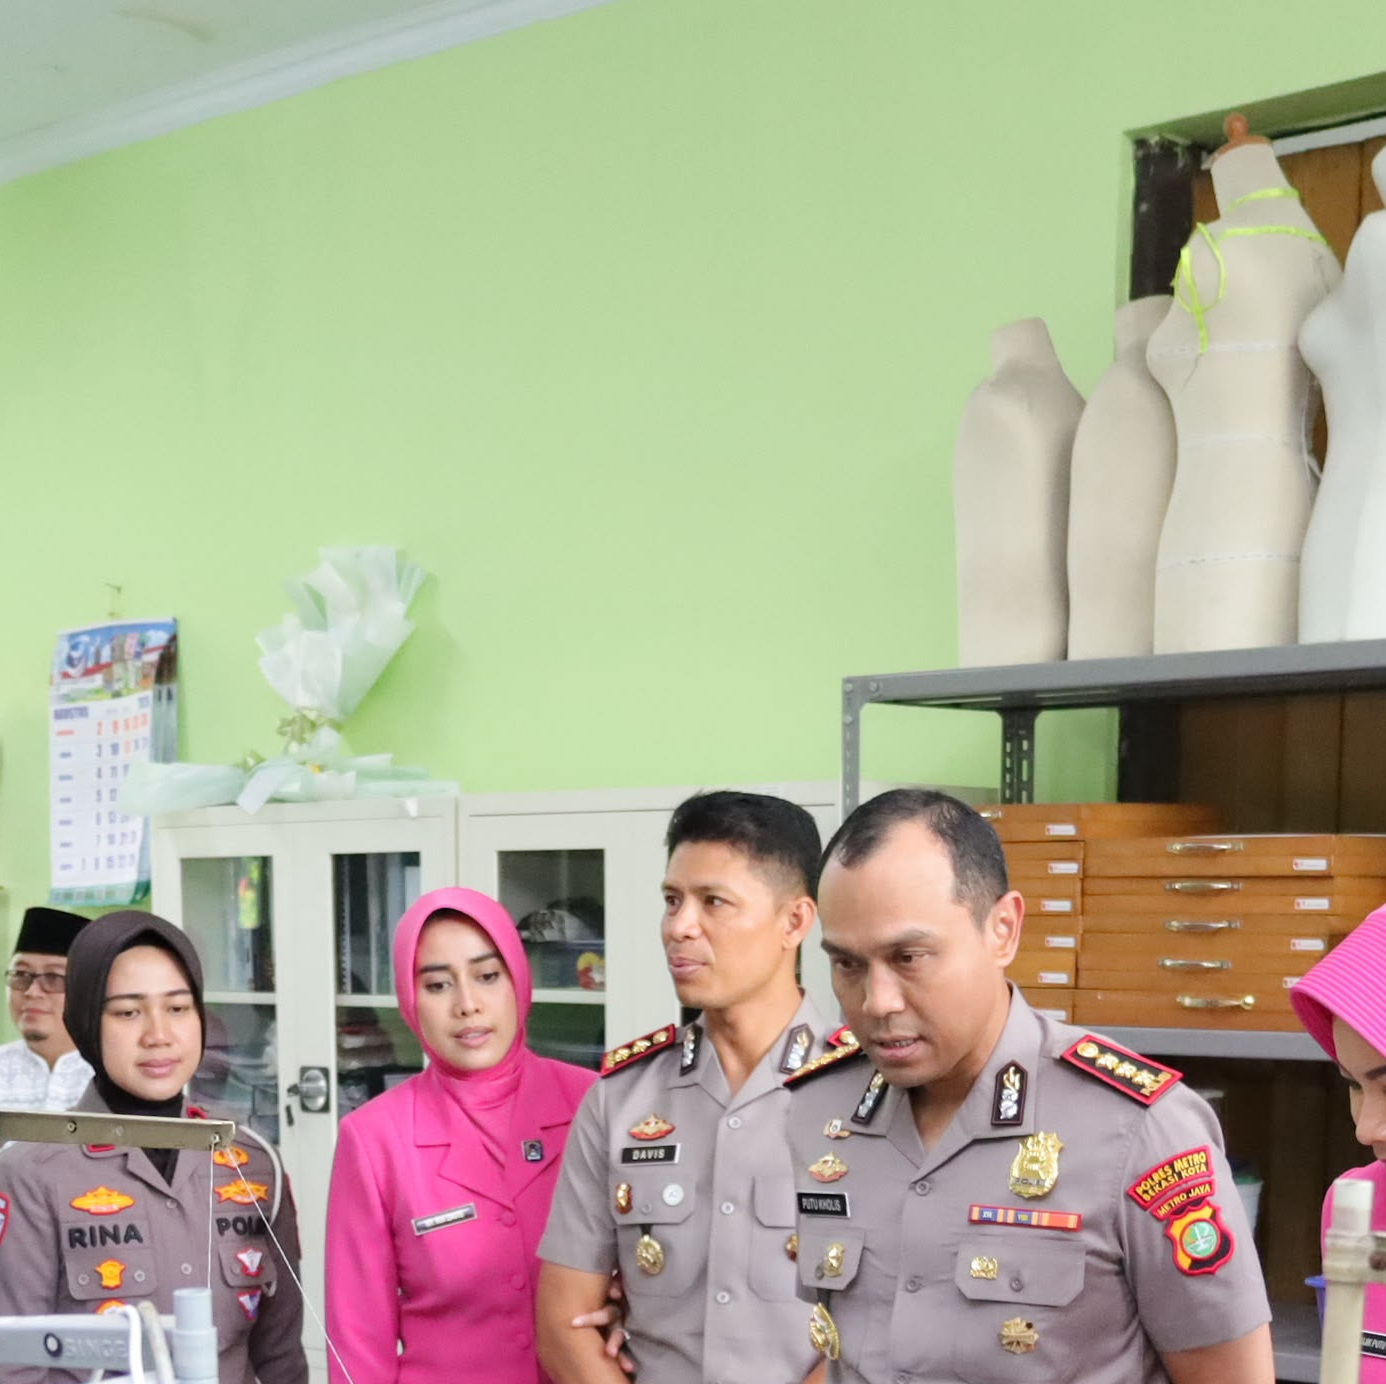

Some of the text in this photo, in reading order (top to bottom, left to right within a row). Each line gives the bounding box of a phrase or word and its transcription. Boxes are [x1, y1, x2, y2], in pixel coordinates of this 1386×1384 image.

[632, 1148, 665, 1160] DAVIS
[1135, 1151, 1207, 1196] POLRES METRO
[1142, 1163, 1208, 1202] BEKASI KOTA
[1156, 1183, 1211, 1216] METRO JAYA
[68, 1222, 144, 1249] RINA
